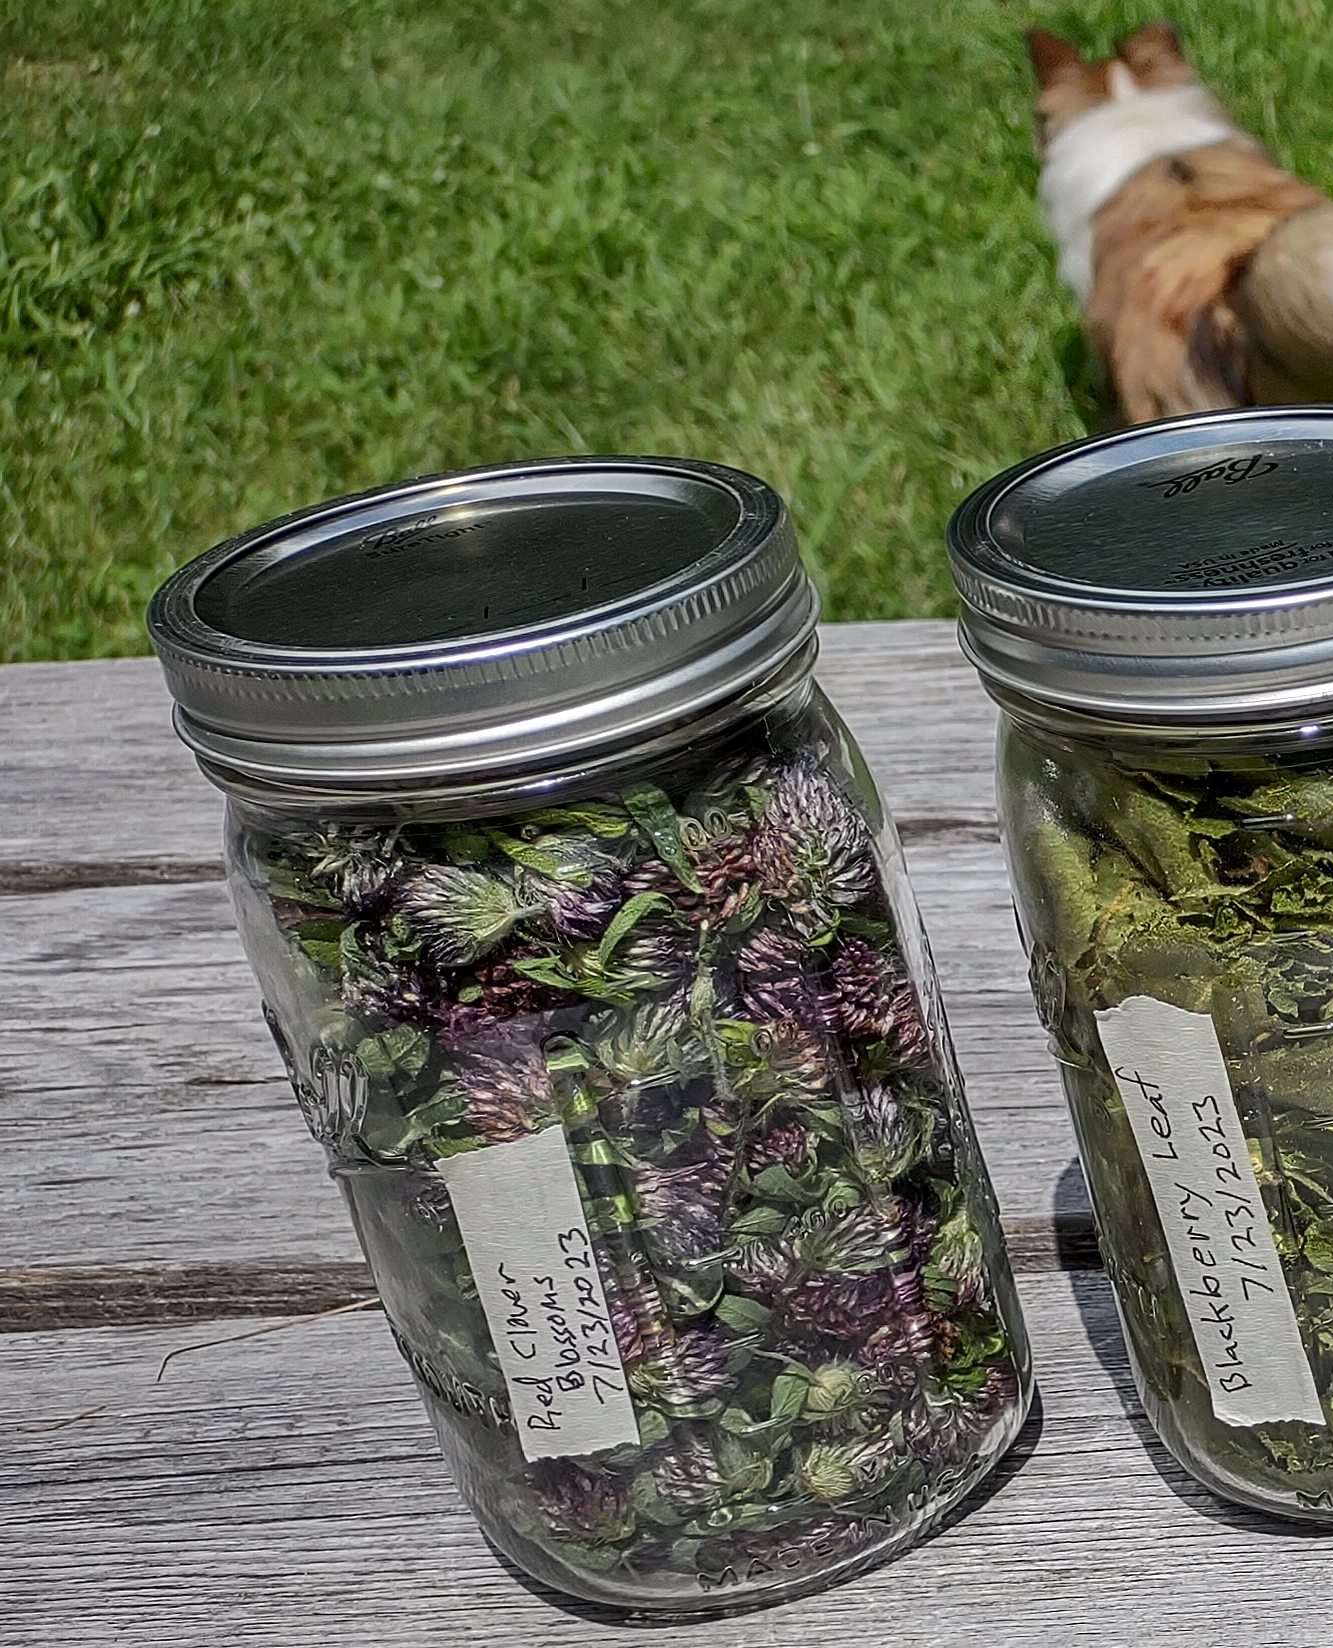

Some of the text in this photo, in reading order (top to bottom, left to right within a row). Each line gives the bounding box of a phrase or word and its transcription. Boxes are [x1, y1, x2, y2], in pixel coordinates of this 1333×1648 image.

[362, 515, 440, 550] Ball
[1147, 454, 1279, 499] Ball
[1114, 1065, 1252, 1393] Blackberry Leaf
[1191, 1093, 1274, 1301] 7/23/2023
[497, 1261, 562, 1431] Red Clover
[531, 1275, 585, 1392] Blossoms
[556, 1227, 624, 1405] 7/23/2023
[697, 1533, 834, 1592] MADE
[849, 1506, 900, 1544] IN
